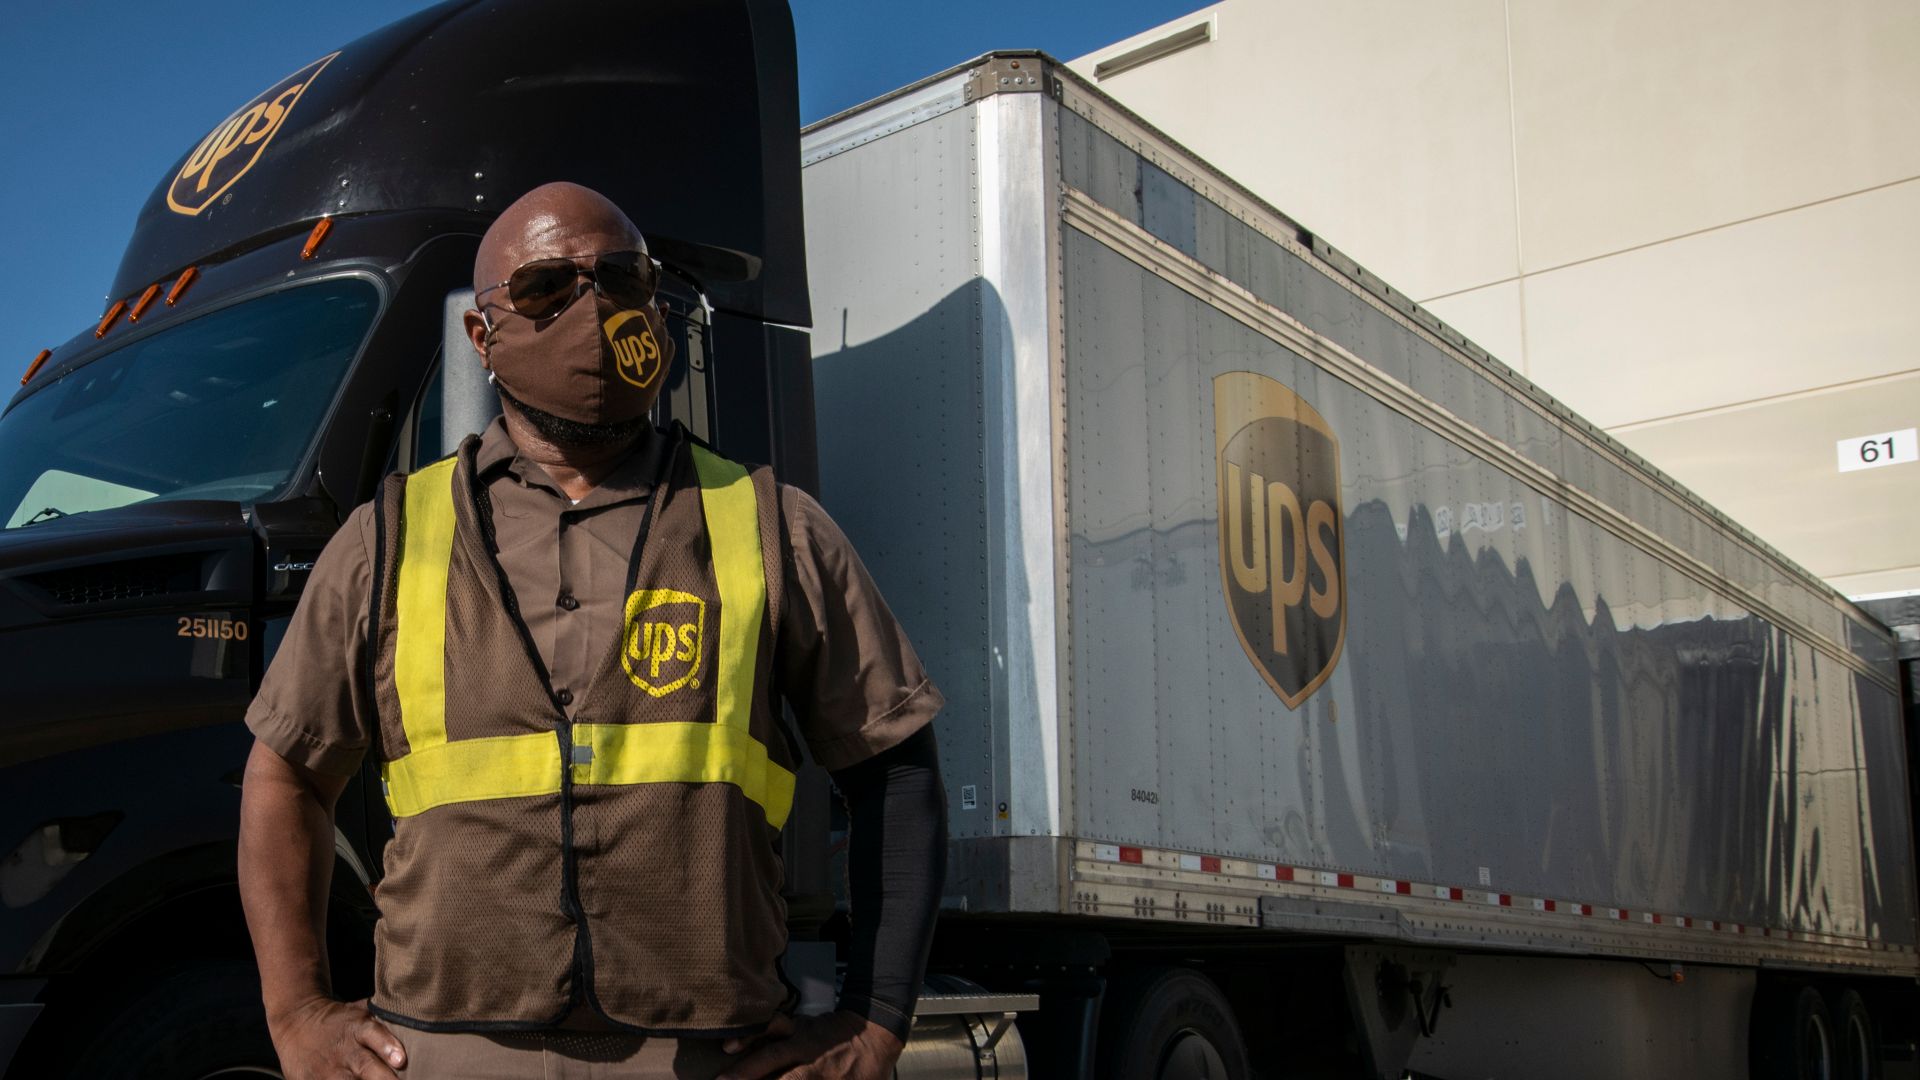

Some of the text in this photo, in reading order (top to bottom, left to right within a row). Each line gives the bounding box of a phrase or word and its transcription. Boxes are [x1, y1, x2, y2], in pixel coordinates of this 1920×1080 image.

[614, 331, 657, 376] ups
[1860, 436, 1894, 463] 61
[1227, 460, 1339, 655] ups
[177, 616, 248, 641] 251150
[628, 622, 697, 677] ups
